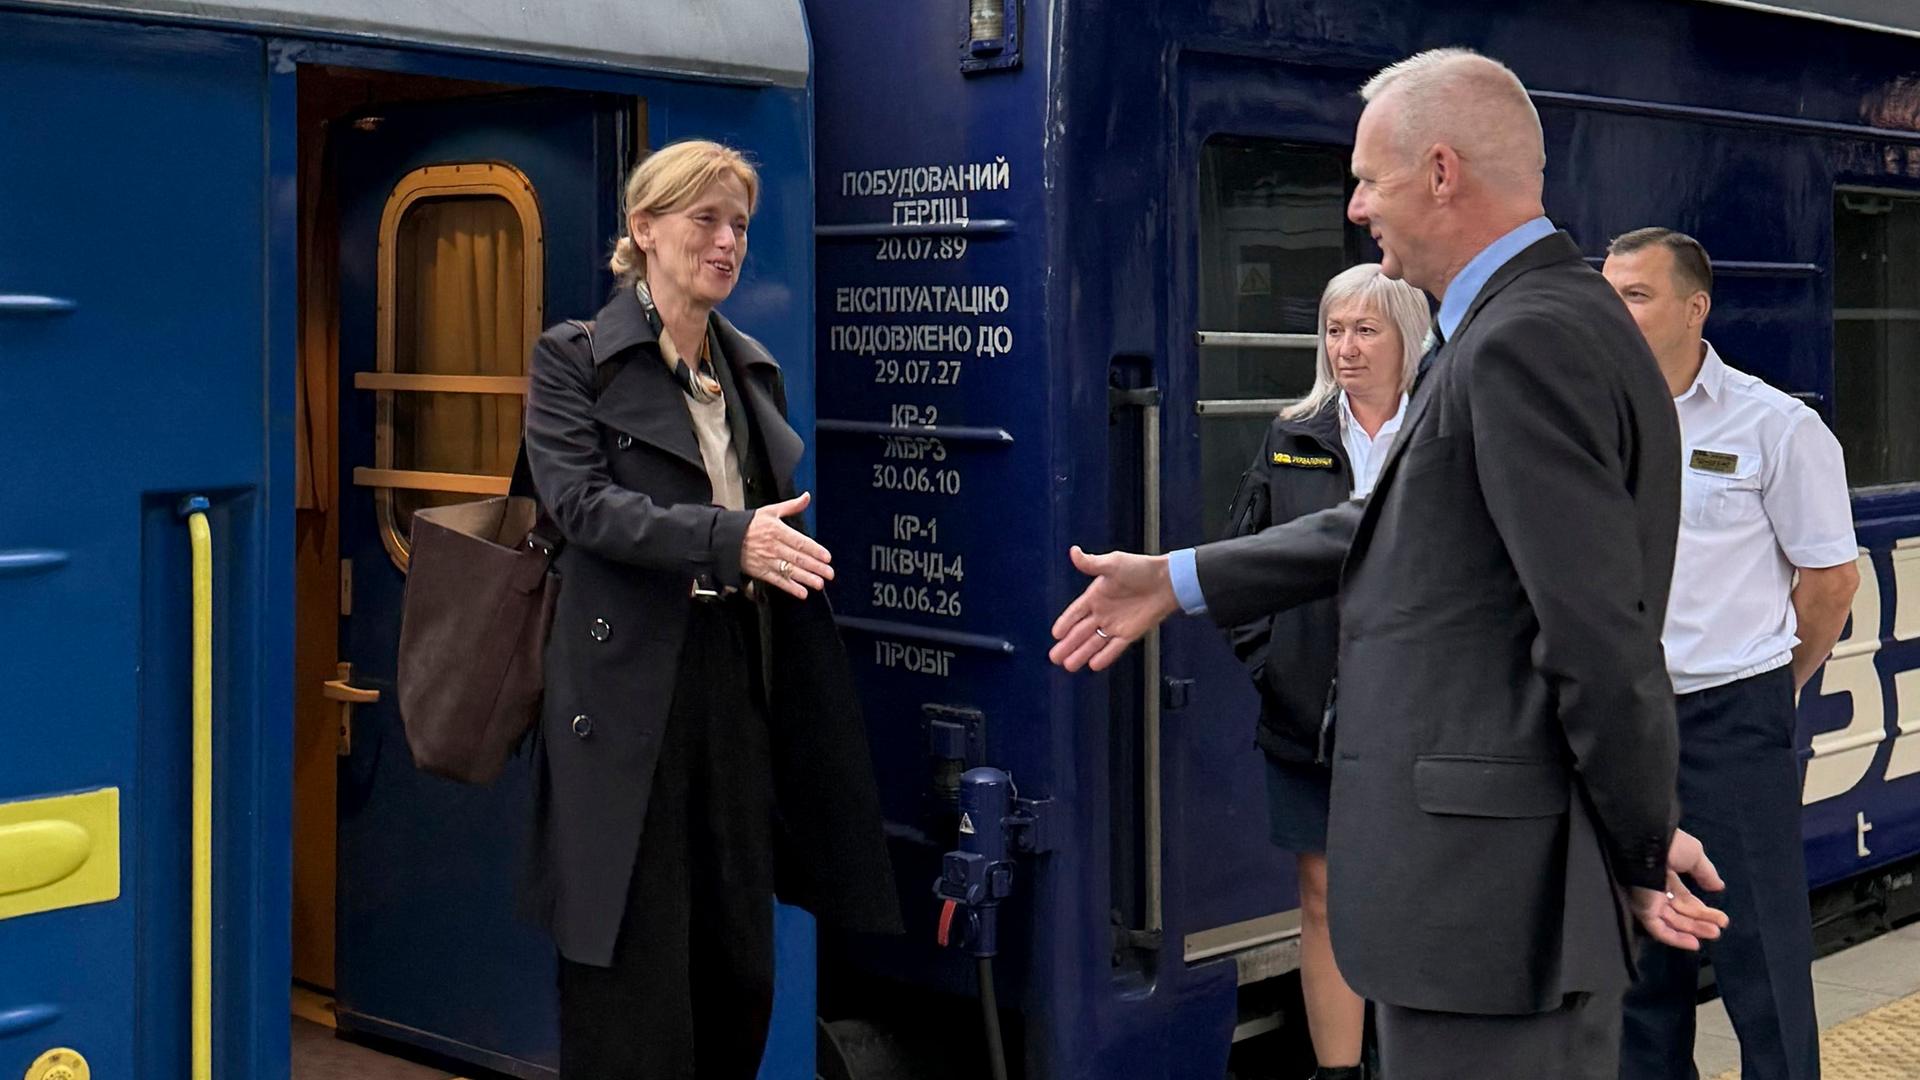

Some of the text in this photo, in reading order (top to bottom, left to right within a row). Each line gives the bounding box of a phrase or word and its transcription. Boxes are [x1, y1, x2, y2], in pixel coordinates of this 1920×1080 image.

[842, 156, 1010, 197] ПОБУДОВАНИЙ
[891, 197, 969, 228] ГЕРЛІЦ
[876, 236, 968, 260] 20.07.89
[836, 286, 1010, 316] ЕКСПЛУАТАЦІЮ
[830, 325, 1013, 358] ПОДОВЖЕНО ДО
[874, 359, 962, 385] 29.07.27
[890, 403, 938, 430] КР-2
[871, 463, 961, 495] 30.06.10
[893, 513, 937, 544] КР-1
[871, 544, 964, 584] ПКВЧД-4
[871, 582, 962, 617] 30.06.26
[875, 640, 956, 677] ПРОБІГ
